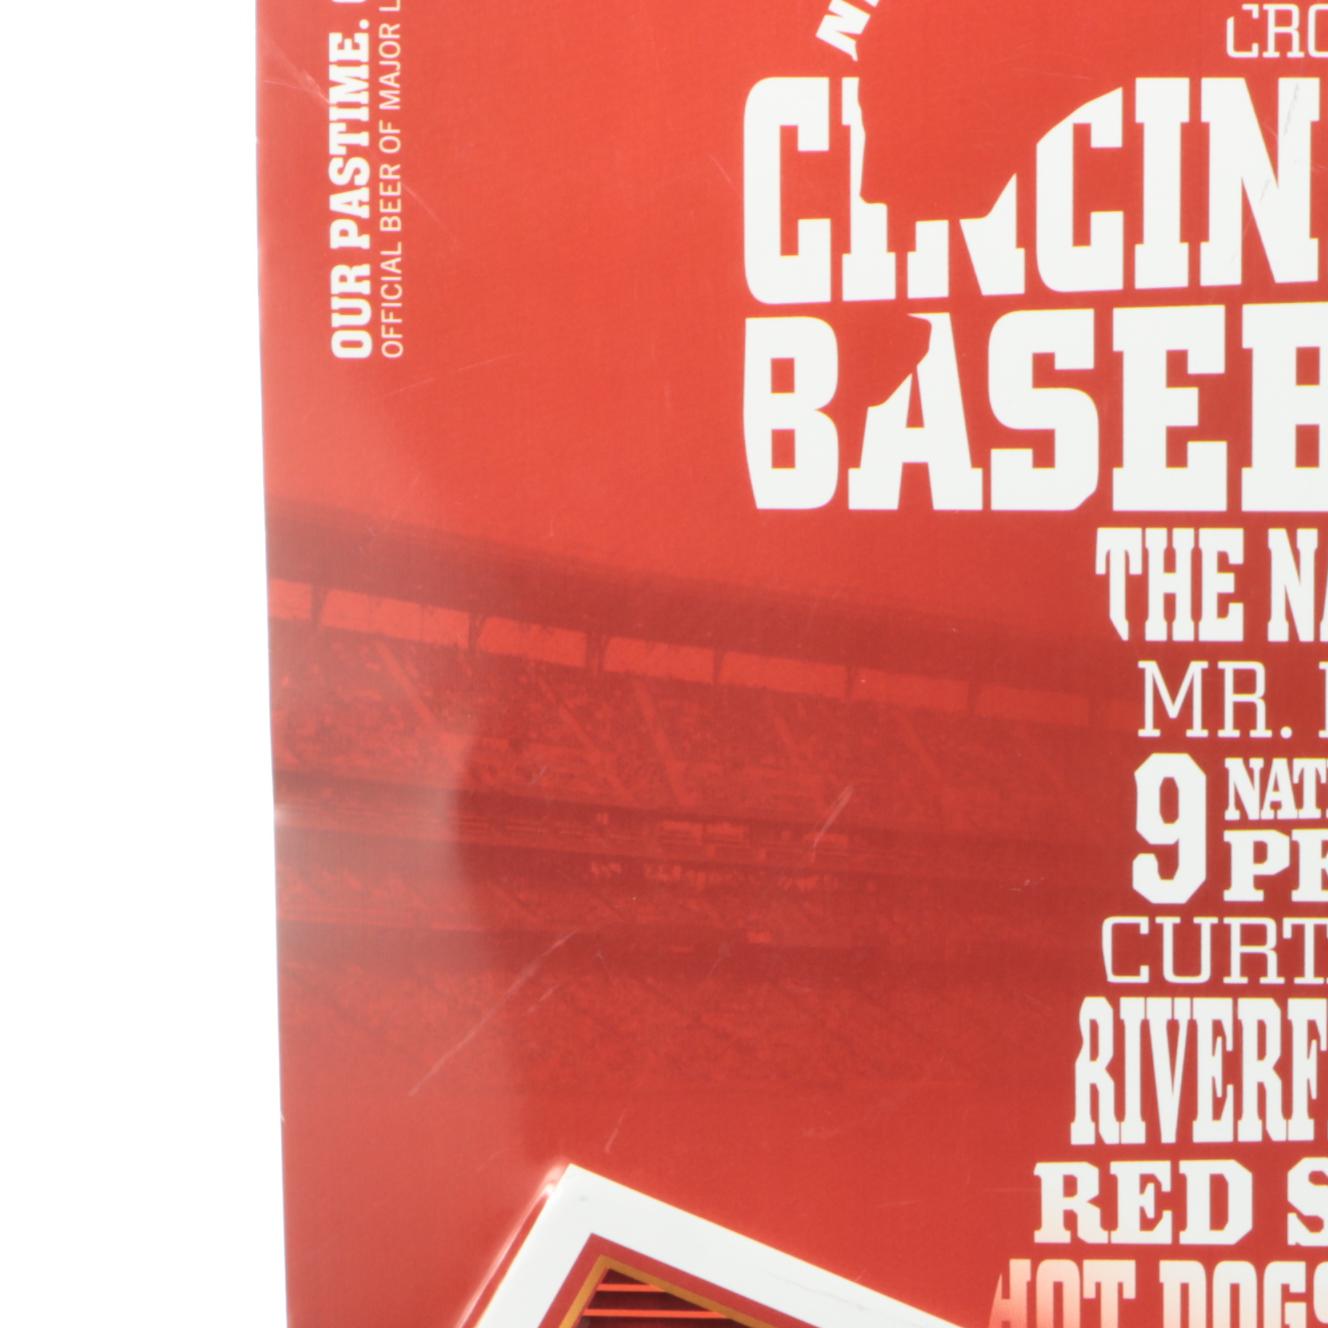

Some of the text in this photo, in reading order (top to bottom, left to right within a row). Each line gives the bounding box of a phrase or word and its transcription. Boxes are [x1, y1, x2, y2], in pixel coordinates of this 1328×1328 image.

[379, 23, 402, 109] MAJOR
[326, 19, 371, 249] PASTIME.
[379, 120, 402, 153] OF
[379, 164, 402, 231] BEER
[330, 264, 373, 358] OUR
[380, 242, 404, 358] OFFICIAL
[1095, 527, 1244, 641] THE
[1137, 660, 1292, 738] MR.
[1132, 753, 1206, 904] 9
[1034, 1159, 1252, 1245] RED
